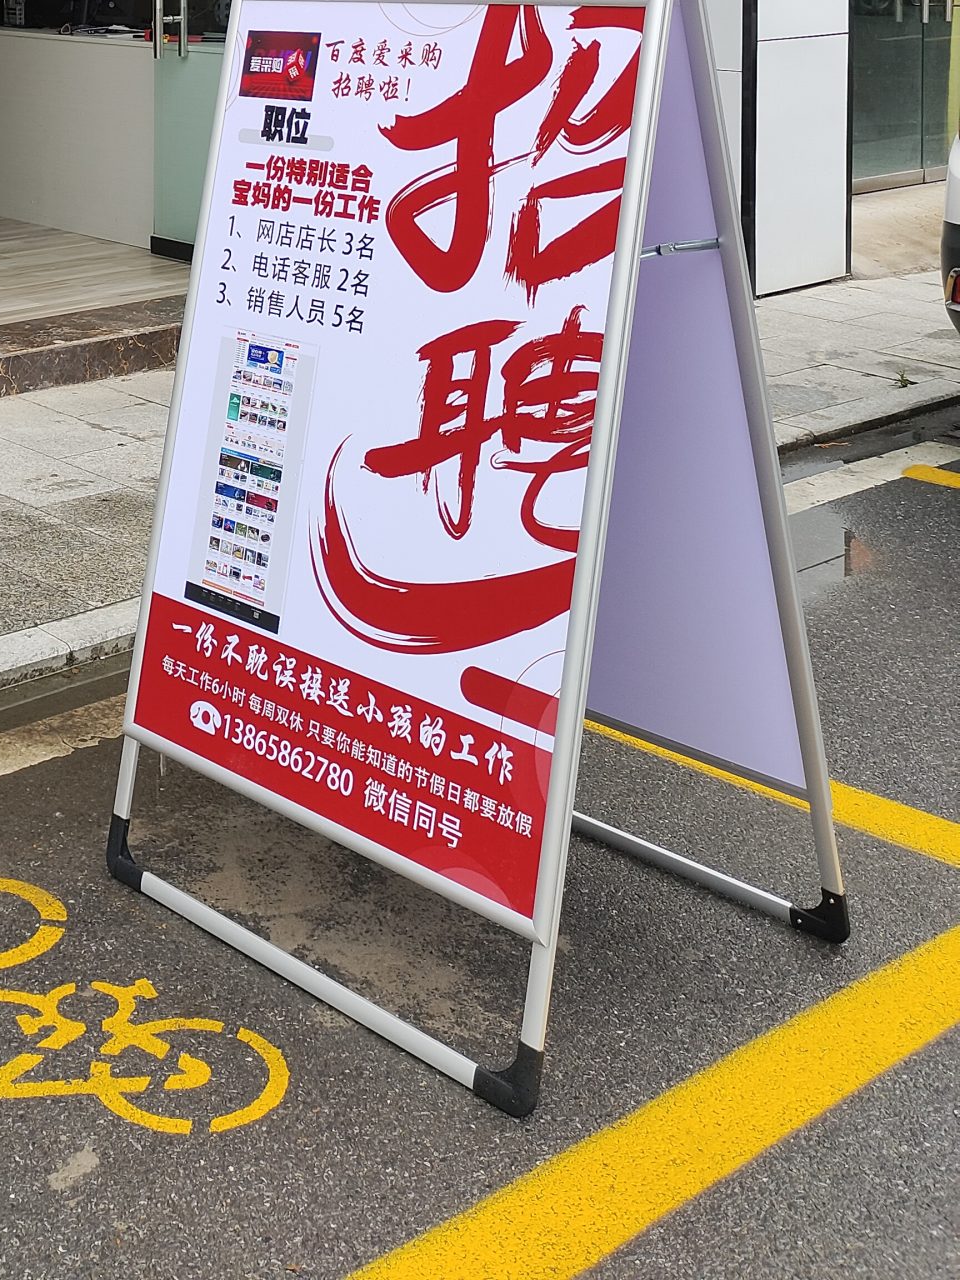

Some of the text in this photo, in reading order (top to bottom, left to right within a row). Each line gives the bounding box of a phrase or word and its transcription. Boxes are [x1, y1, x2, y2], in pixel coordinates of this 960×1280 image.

[249, 56, 284, 73] 爱采购
[325, 38, 442, 70] 百度爱采购
[331, 72, 411, 102] 招聘啦!
[261, 104, 311, 144] 职位
[246, 154, 373, 193] 一份特别适合
[232, 179, 381, 224] 宝妈的一份工作
[223, 713, 463, 849] 13865862780 微信同号
